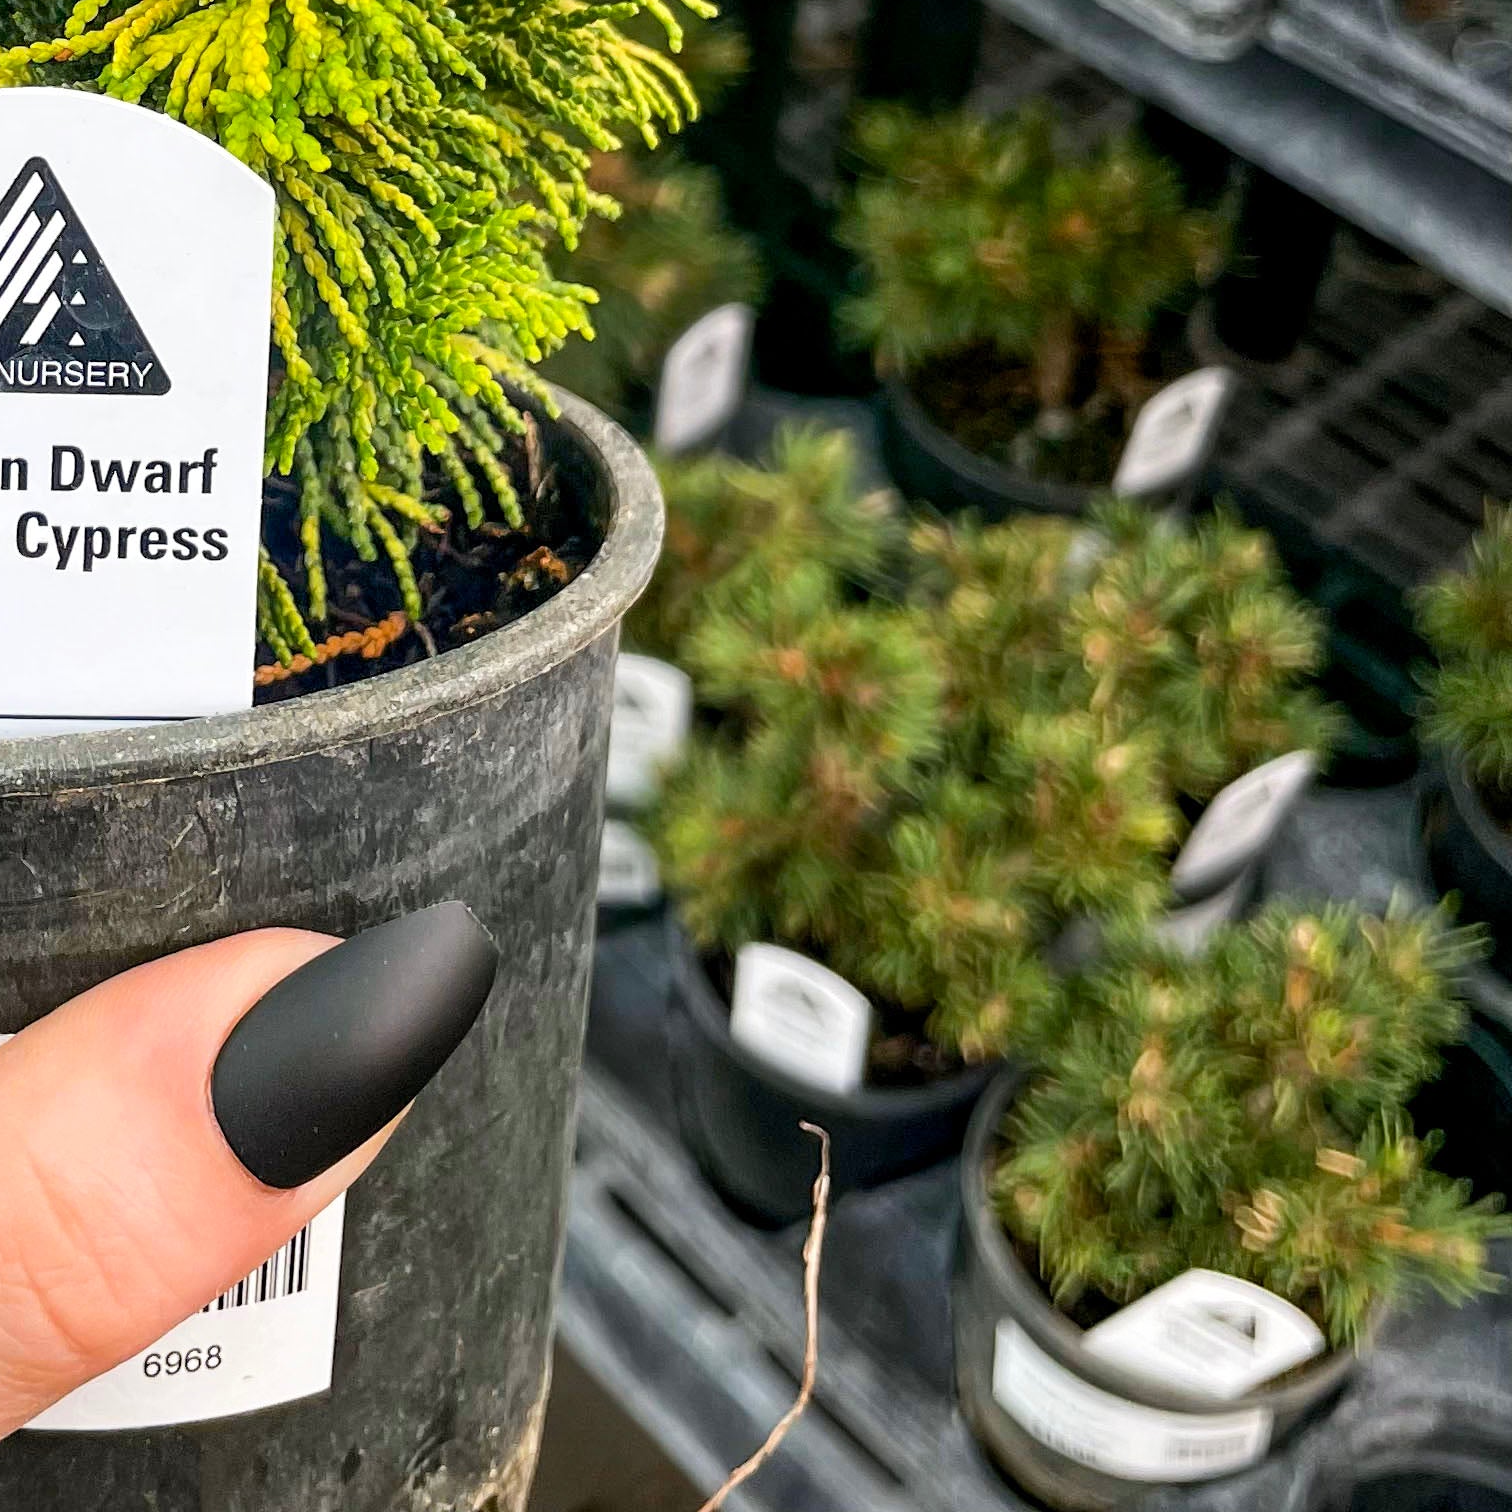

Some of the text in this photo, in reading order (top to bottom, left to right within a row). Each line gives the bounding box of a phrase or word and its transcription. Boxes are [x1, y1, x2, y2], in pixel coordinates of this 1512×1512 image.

[51, 444, 218, 494] Dwarf
[15, 510, 230, 573] Cypress
[143, 1344, 223, 1378] 6968
